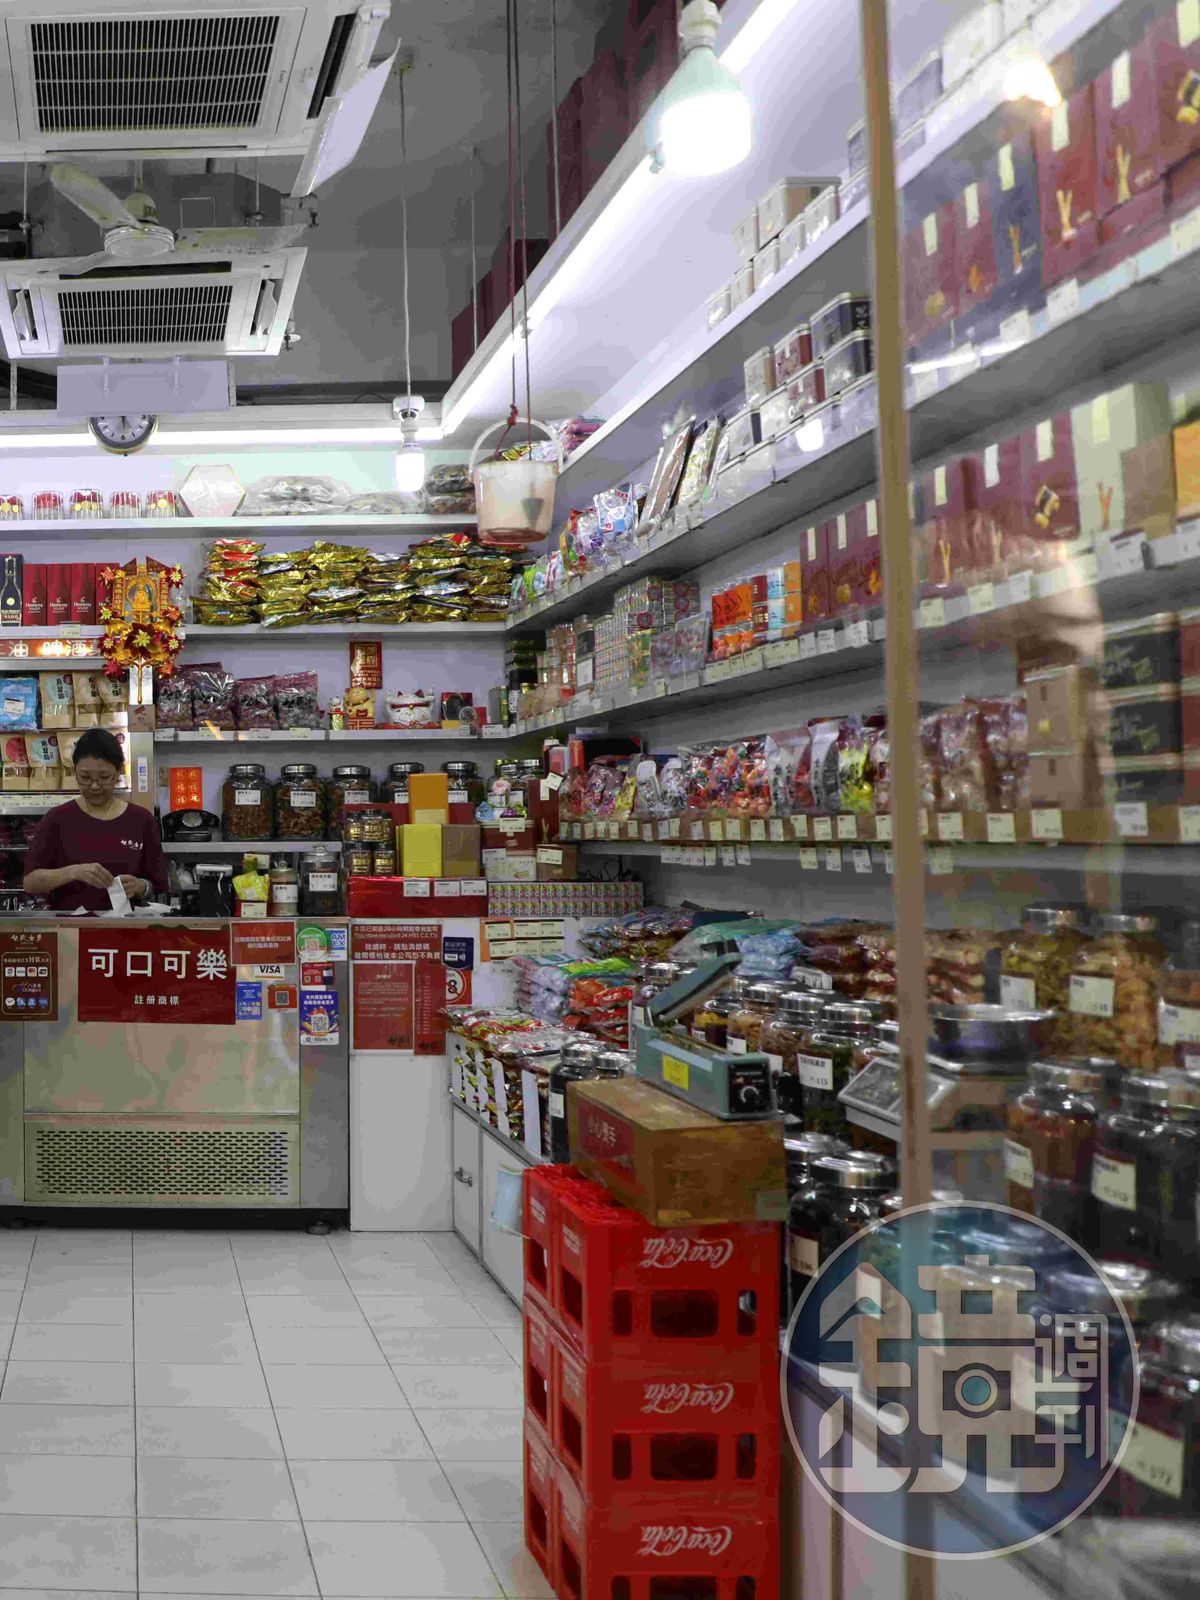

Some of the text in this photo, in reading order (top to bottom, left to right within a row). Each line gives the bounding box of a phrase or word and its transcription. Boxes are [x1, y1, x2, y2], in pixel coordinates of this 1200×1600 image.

[87, 948, 228, 981] 可口可樂
[259, 965, 281, 974] VISA
